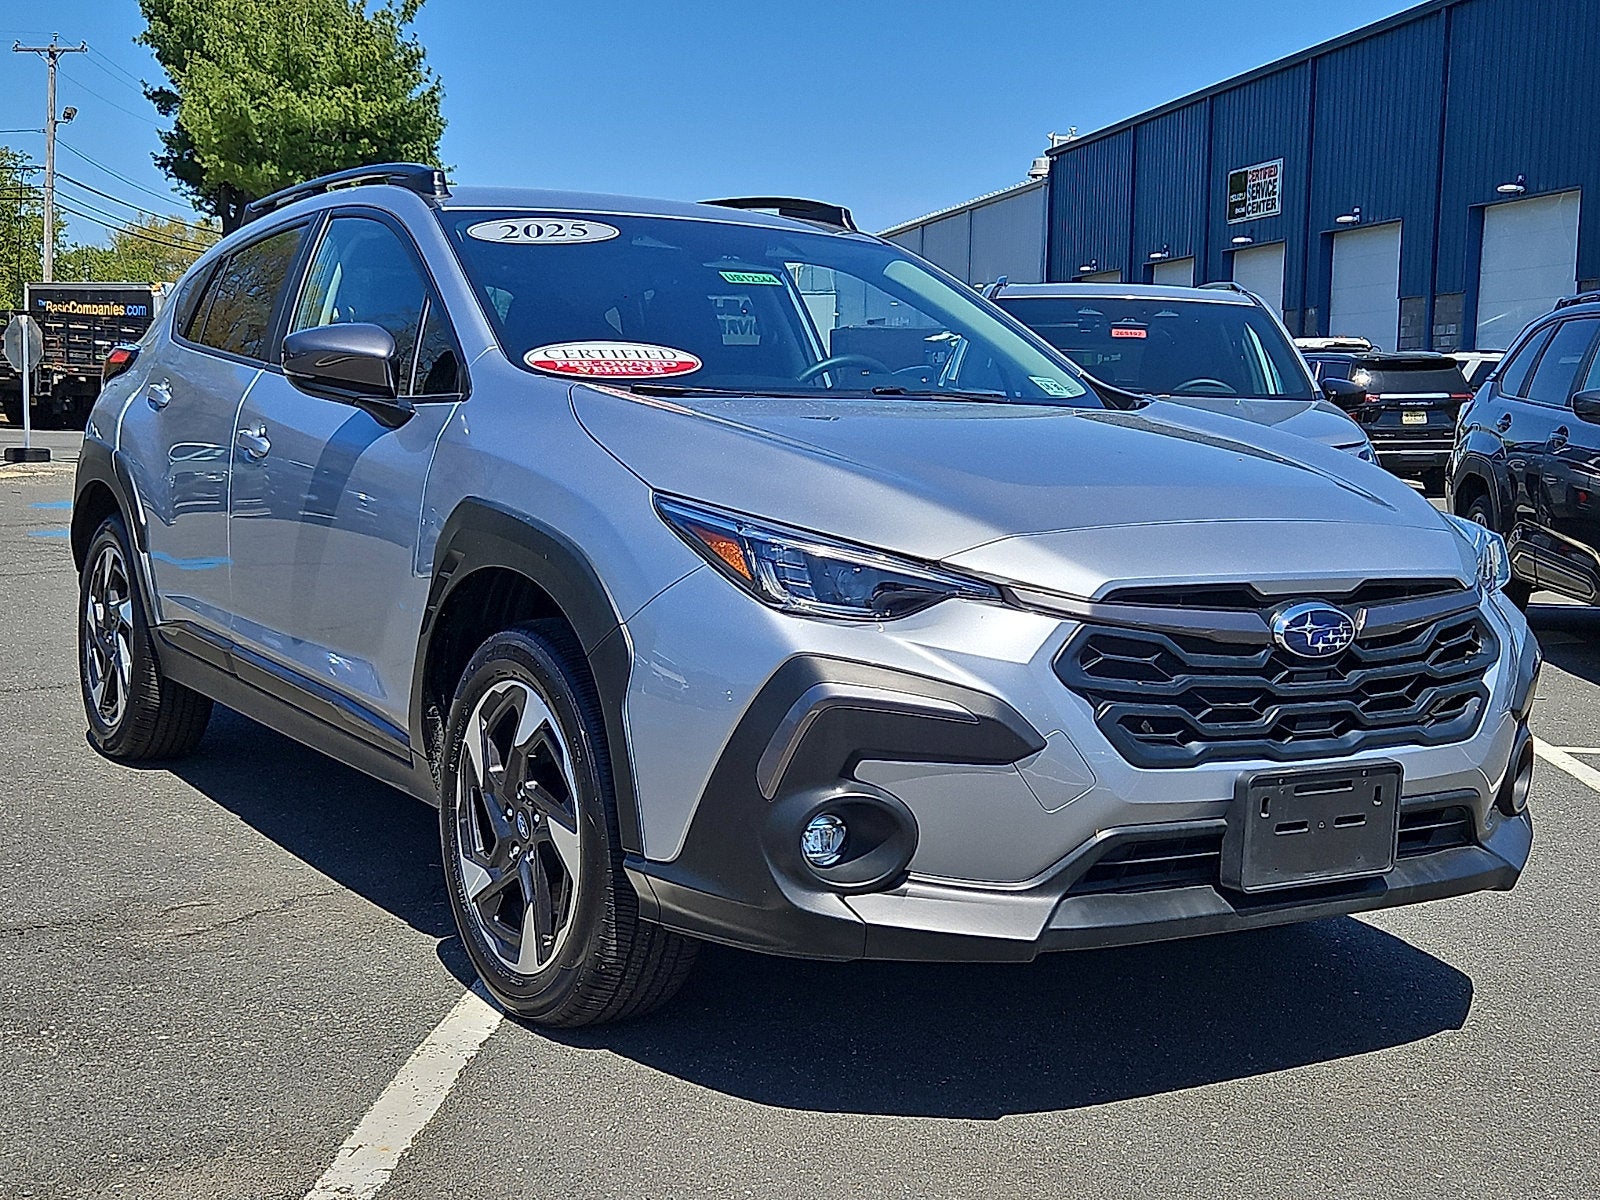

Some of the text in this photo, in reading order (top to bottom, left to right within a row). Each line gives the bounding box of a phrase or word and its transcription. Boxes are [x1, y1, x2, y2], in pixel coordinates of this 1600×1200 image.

[1249, 164, 1278, 182] CERTIFIED
[1248, 178, 1278, 201] SERVICE
[1246, 197, 1277, 215] CENTER
[499, 223, 588, 239] 2025
[543, 349, 677, 359] CERTIFIED
[554, 360, 679, 368] PRE-OWNED
[576, 366, 666, 374] VEHICLE
